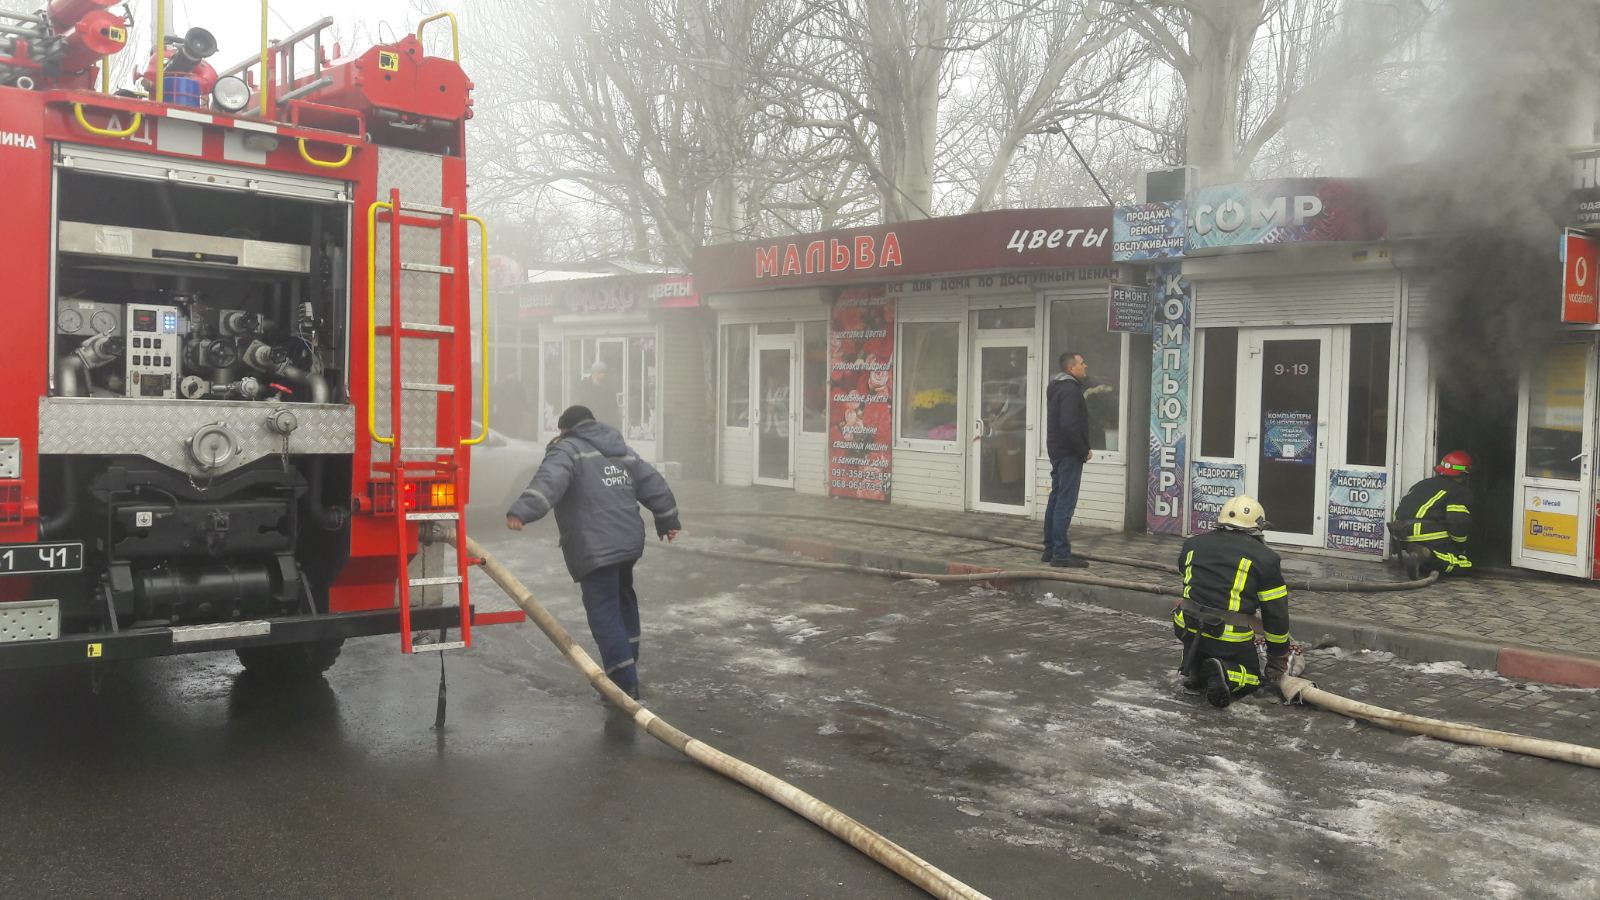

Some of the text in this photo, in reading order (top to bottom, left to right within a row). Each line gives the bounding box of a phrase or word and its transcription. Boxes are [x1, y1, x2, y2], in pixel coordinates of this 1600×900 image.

[0, 131, 37, 149] ИНА
[1126, 209, 1171, 221] ПРОДАЖА
[1195, 195, 1323, 235] COMP
[1130, 224, 1166, 236] РЕМОНТ
[1113, 238, 1184, 252] ОБСЛУЖИВАНИЕ
[755, 232, 903, 278] МАЛЬВА
[888, 268, 1120, 293] ВСЕ ДЛЯ ДОМА ПО ДОСТУПНЫМ ЦЕНАМ
[1114, 290, 1150, 302] РЕМОНТ:
[1569, 290, 1593, 304] vodafone
[1155, 274, 1184, 518] КОМПЬЮТЕРЫ
[1198, 467, 1240, 479] НЕДОРОГИЕ
[1337, 475, 1383, 489] НАСТРОЙКА
[1201, 485, 1235, 497] МОЩНЫЕ
[1350, 490, 1369, 502] ПО
[1193, 502, 1223, 512] КОМПЬЮ
[1197, 520, 1206, 529] ИЗ
[1338, 520, 1376, 532] ИНТЕРНЕТ
[1332, 534, 1384, 549] ТЕЛЕВИДЕНИЕ
[0, 549, 14, 570] 1
